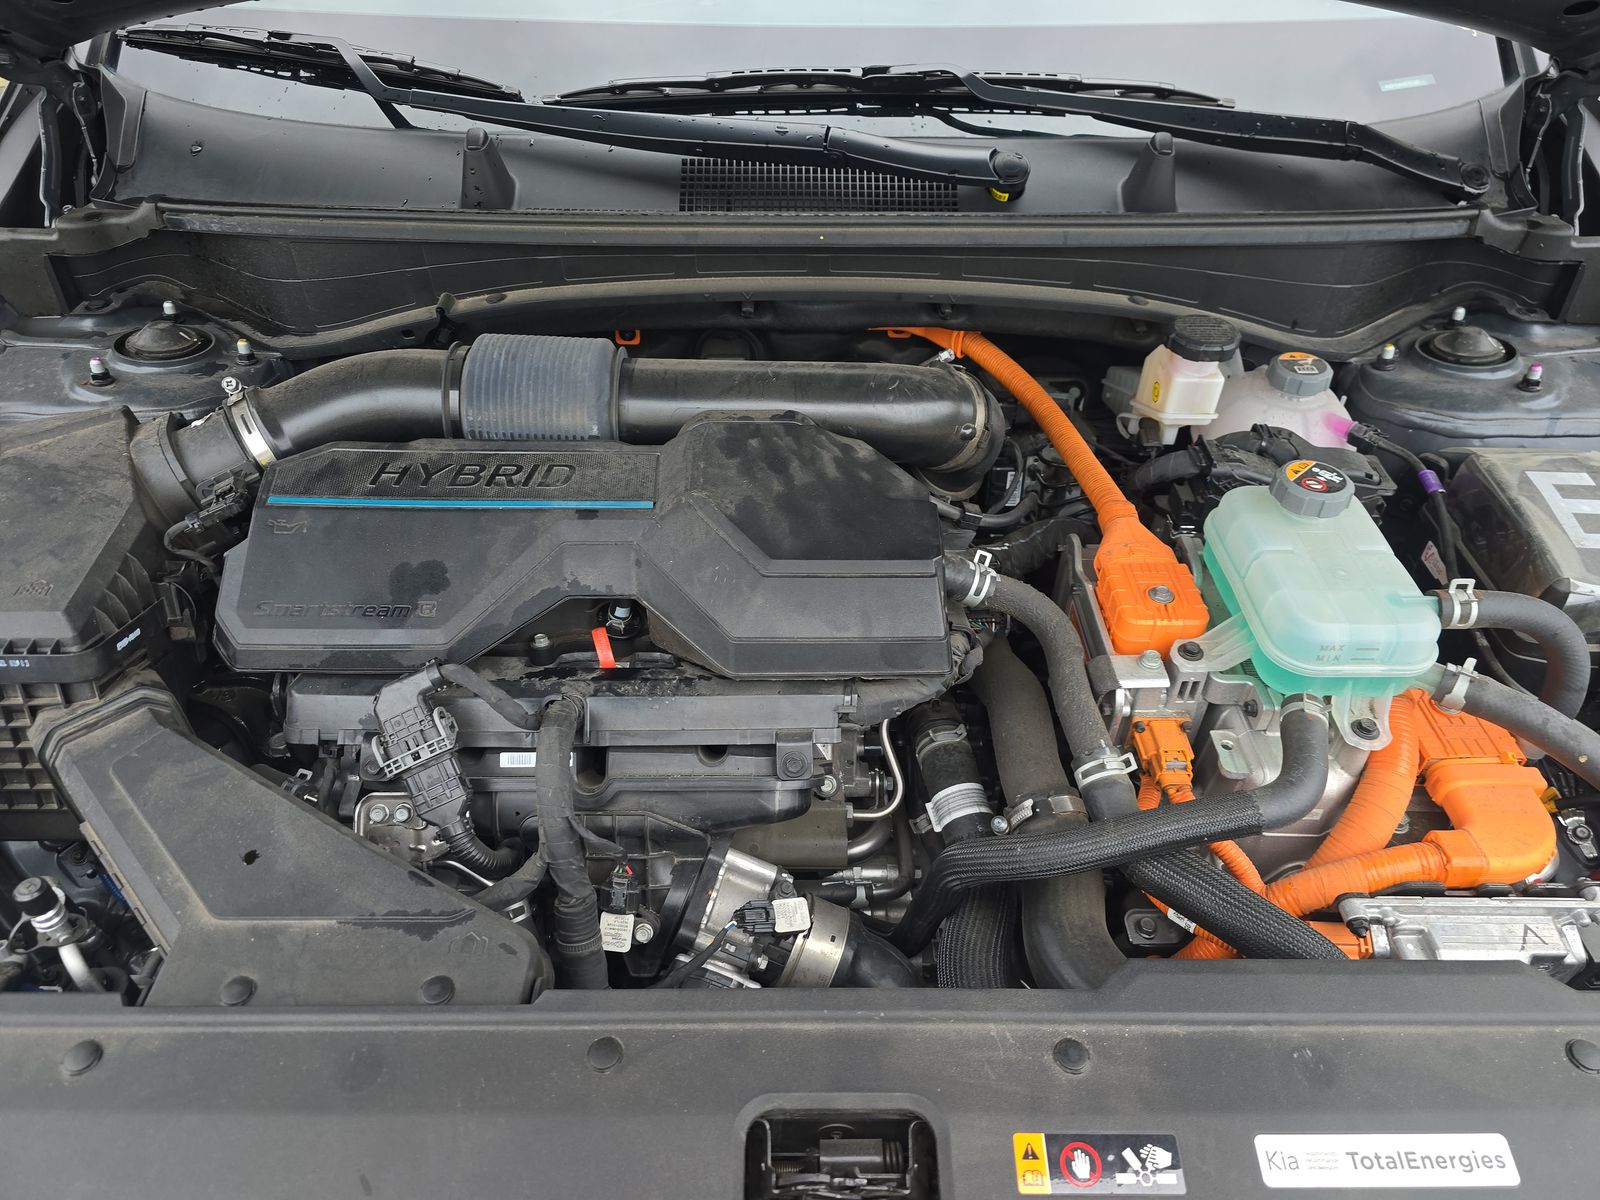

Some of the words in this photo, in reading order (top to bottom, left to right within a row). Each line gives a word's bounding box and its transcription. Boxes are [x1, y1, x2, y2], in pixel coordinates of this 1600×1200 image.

[368, 461, 577, 489] HYBRID
[252, 600, 413, 618] Smartstream
[1319, 643, 1345, 652] MAX
[1265, 1150, 1299, 1171] Kia
[1345, 1150, 1507, 1173] TotalEnergies
